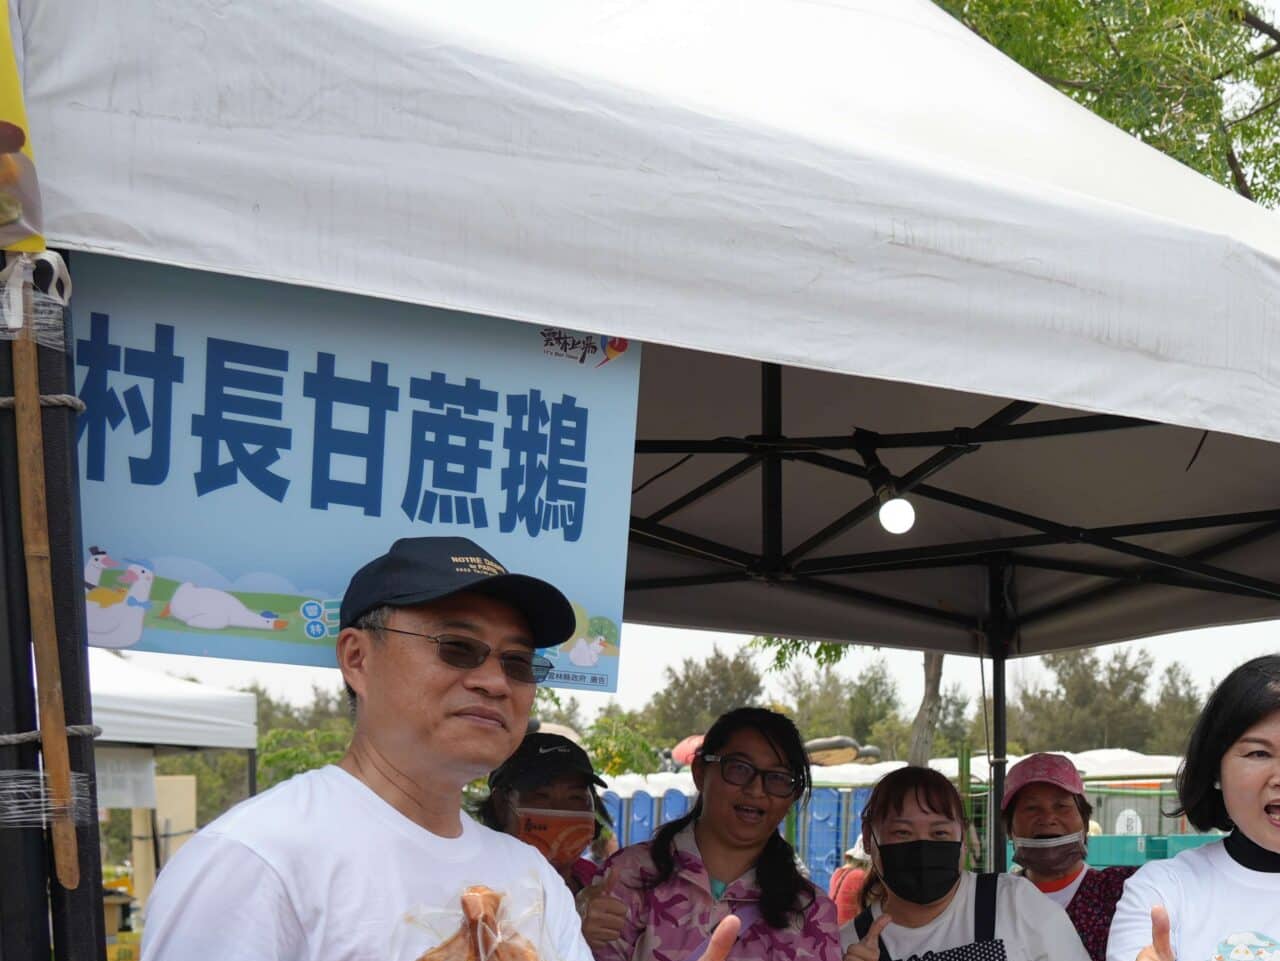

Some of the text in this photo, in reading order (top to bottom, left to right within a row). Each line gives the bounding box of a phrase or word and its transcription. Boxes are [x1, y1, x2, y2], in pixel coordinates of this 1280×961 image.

[76, 311, 590, 543] 村長甘蔗鵝
